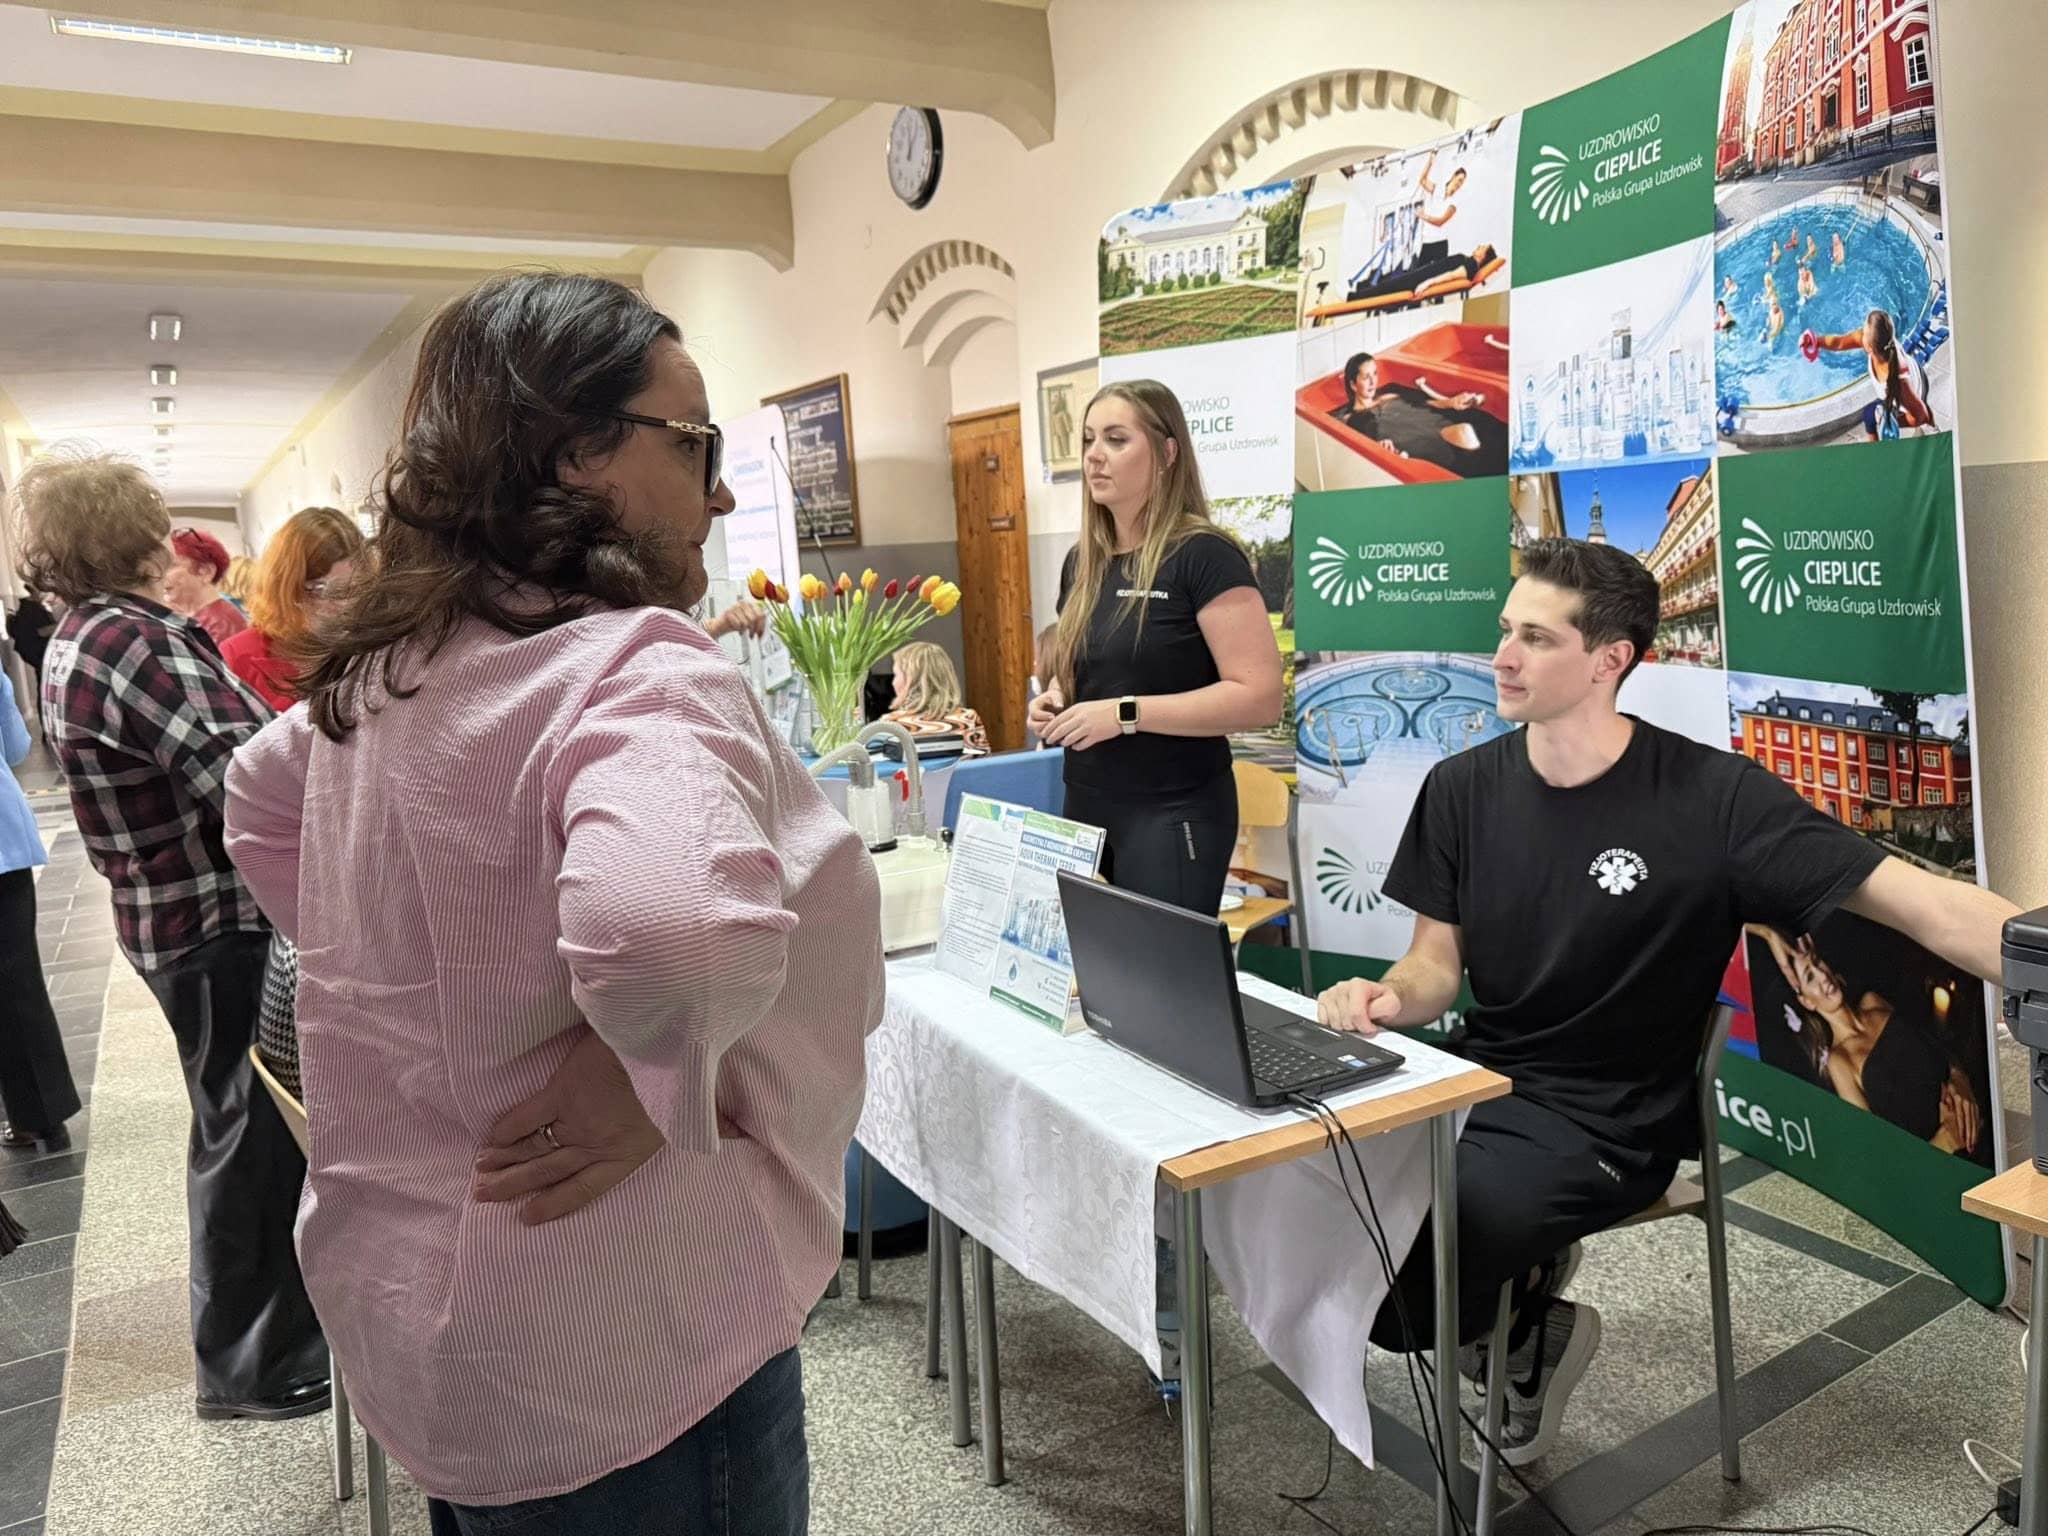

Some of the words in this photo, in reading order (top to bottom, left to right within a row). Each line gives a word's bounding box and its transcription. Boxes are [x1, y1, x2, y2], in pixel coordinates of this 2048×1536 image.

[1578, 113, 1660, 160] UZDROWISKO
[1594, 139, 1662, 183] CIEPLICE
[1593, 187, 1622, 208] Polska
[1624, 177, 1653, 197] Grupa
[1655, 154, 1703, 186] Uzdrowisk
[1182, 396, 1230, 414] OWISKO
[1187, 416, 1234, 435] PLICE
[1198, 441, 1228, 454] Grupa
[1229, 435, 1280, 450] Uzdrowisk
[1358, 541, 1444, 560] UZDROWISKO
[1783, 529, 1874, 551] UZDROWISKO
[1377, 563, 1449, 583] CIEPLICE
[1804, 560, 1882, 586] CIEPLICE
[1377, 589, 1409, 602] Polska
[1411, 588, 1442, 605] Grupa
[1444, 587, 1497, 601] Uzdrowisk
[1806, 595, 1839, 613] Polska
[1840, 596, 1876, 618] Grupa
[1878, 598, 1942, 617] Uzdrowisk
[1588, 848, 1649, 880] FIZJOTERAPEUTA
[1714, 1078, 1816, 1159] ice.pl
